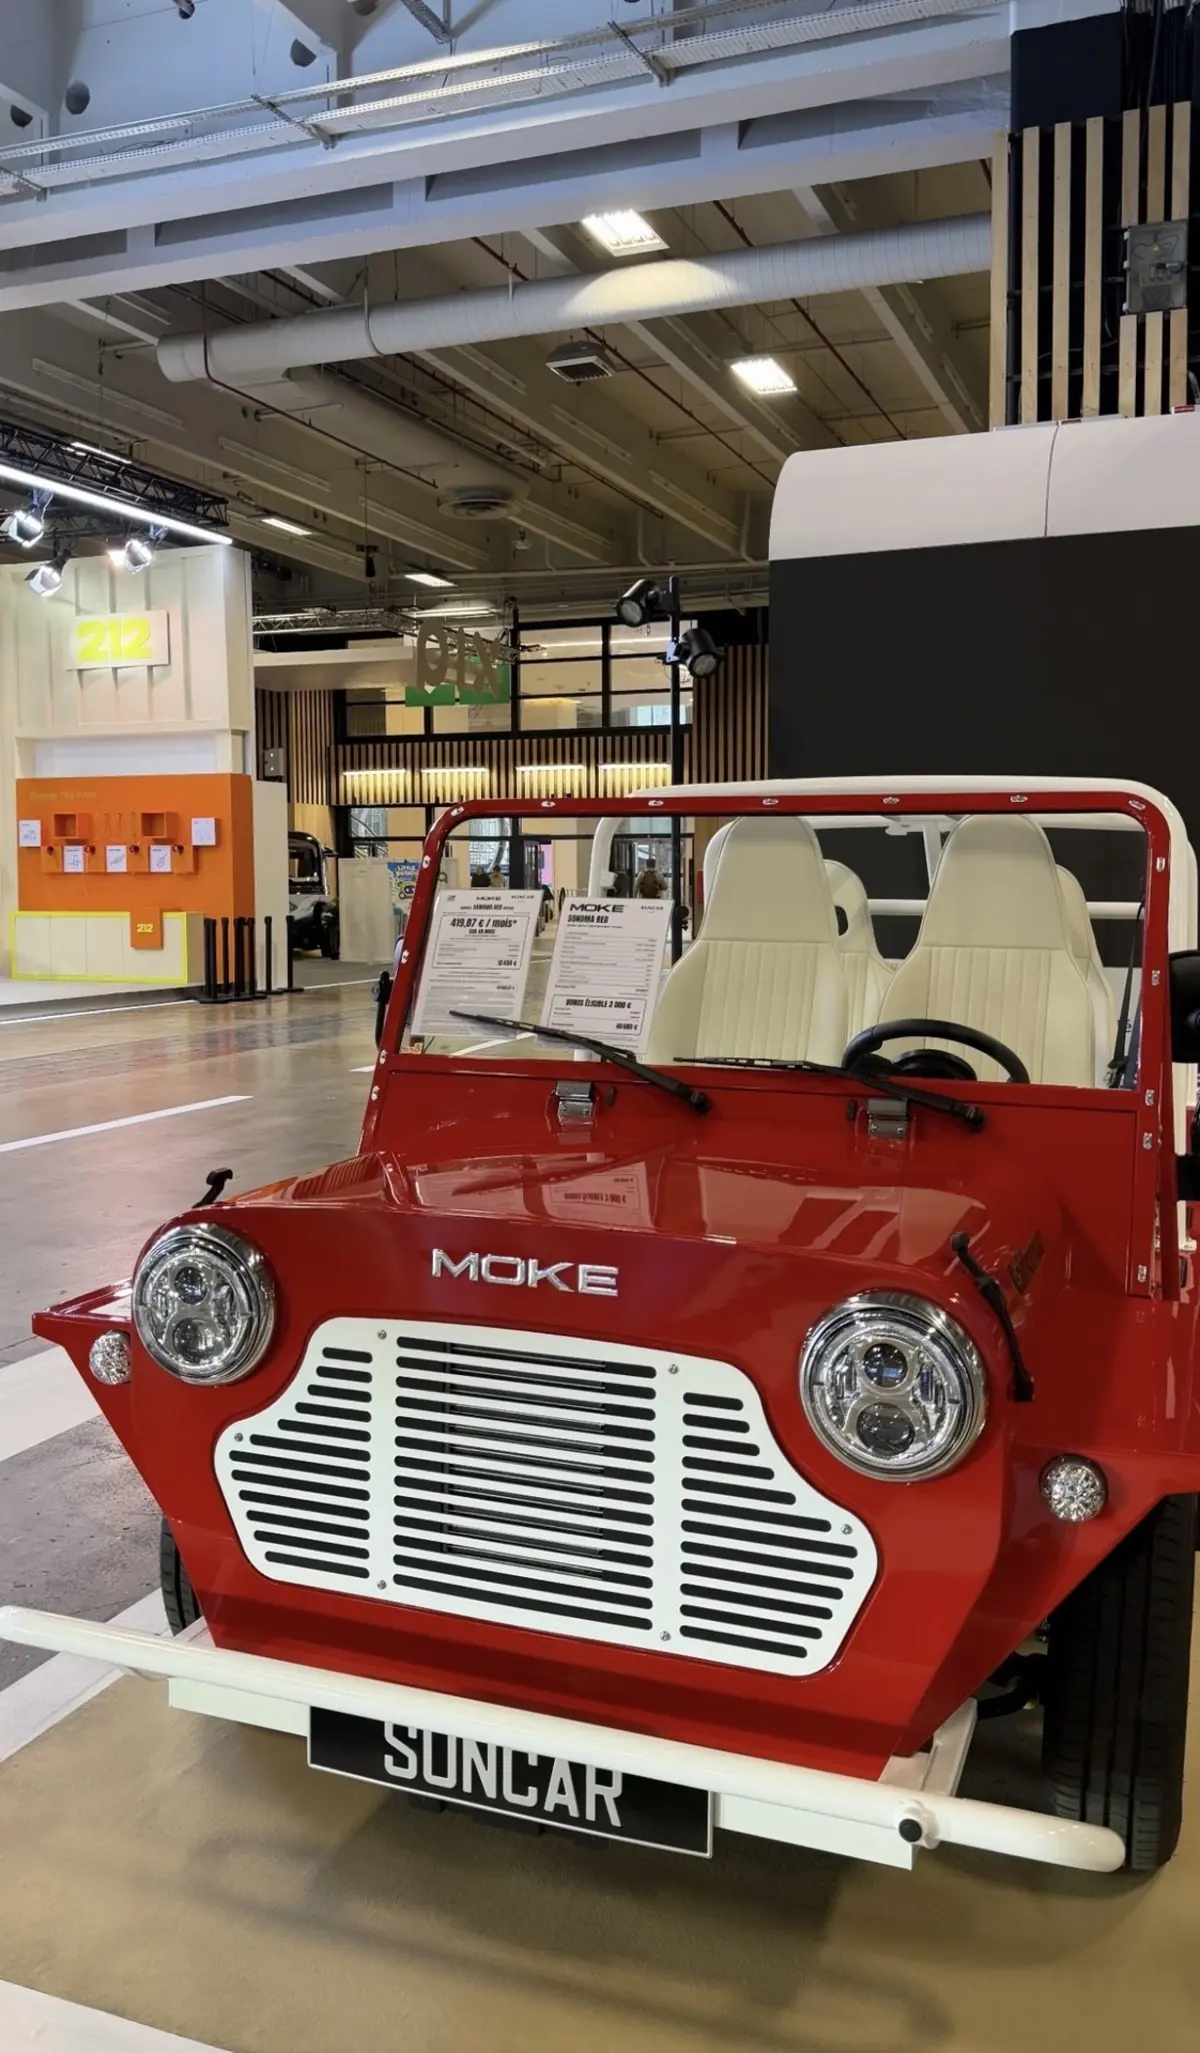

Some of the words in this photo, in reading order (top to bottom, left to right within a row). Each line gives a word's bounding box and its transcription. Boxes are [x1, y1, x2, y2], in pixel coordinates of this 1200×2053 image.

[77, 618, 151, 662] 212
[570, 903, 624, 913] MOKE
[478, 919, 485, 928] €
[568, 914, 595, 923] SONOMA
[596, 915, 609, 924] RED
[136, 923, 153, 933] 212
[432, 1248, 619, 1297] MOKE
